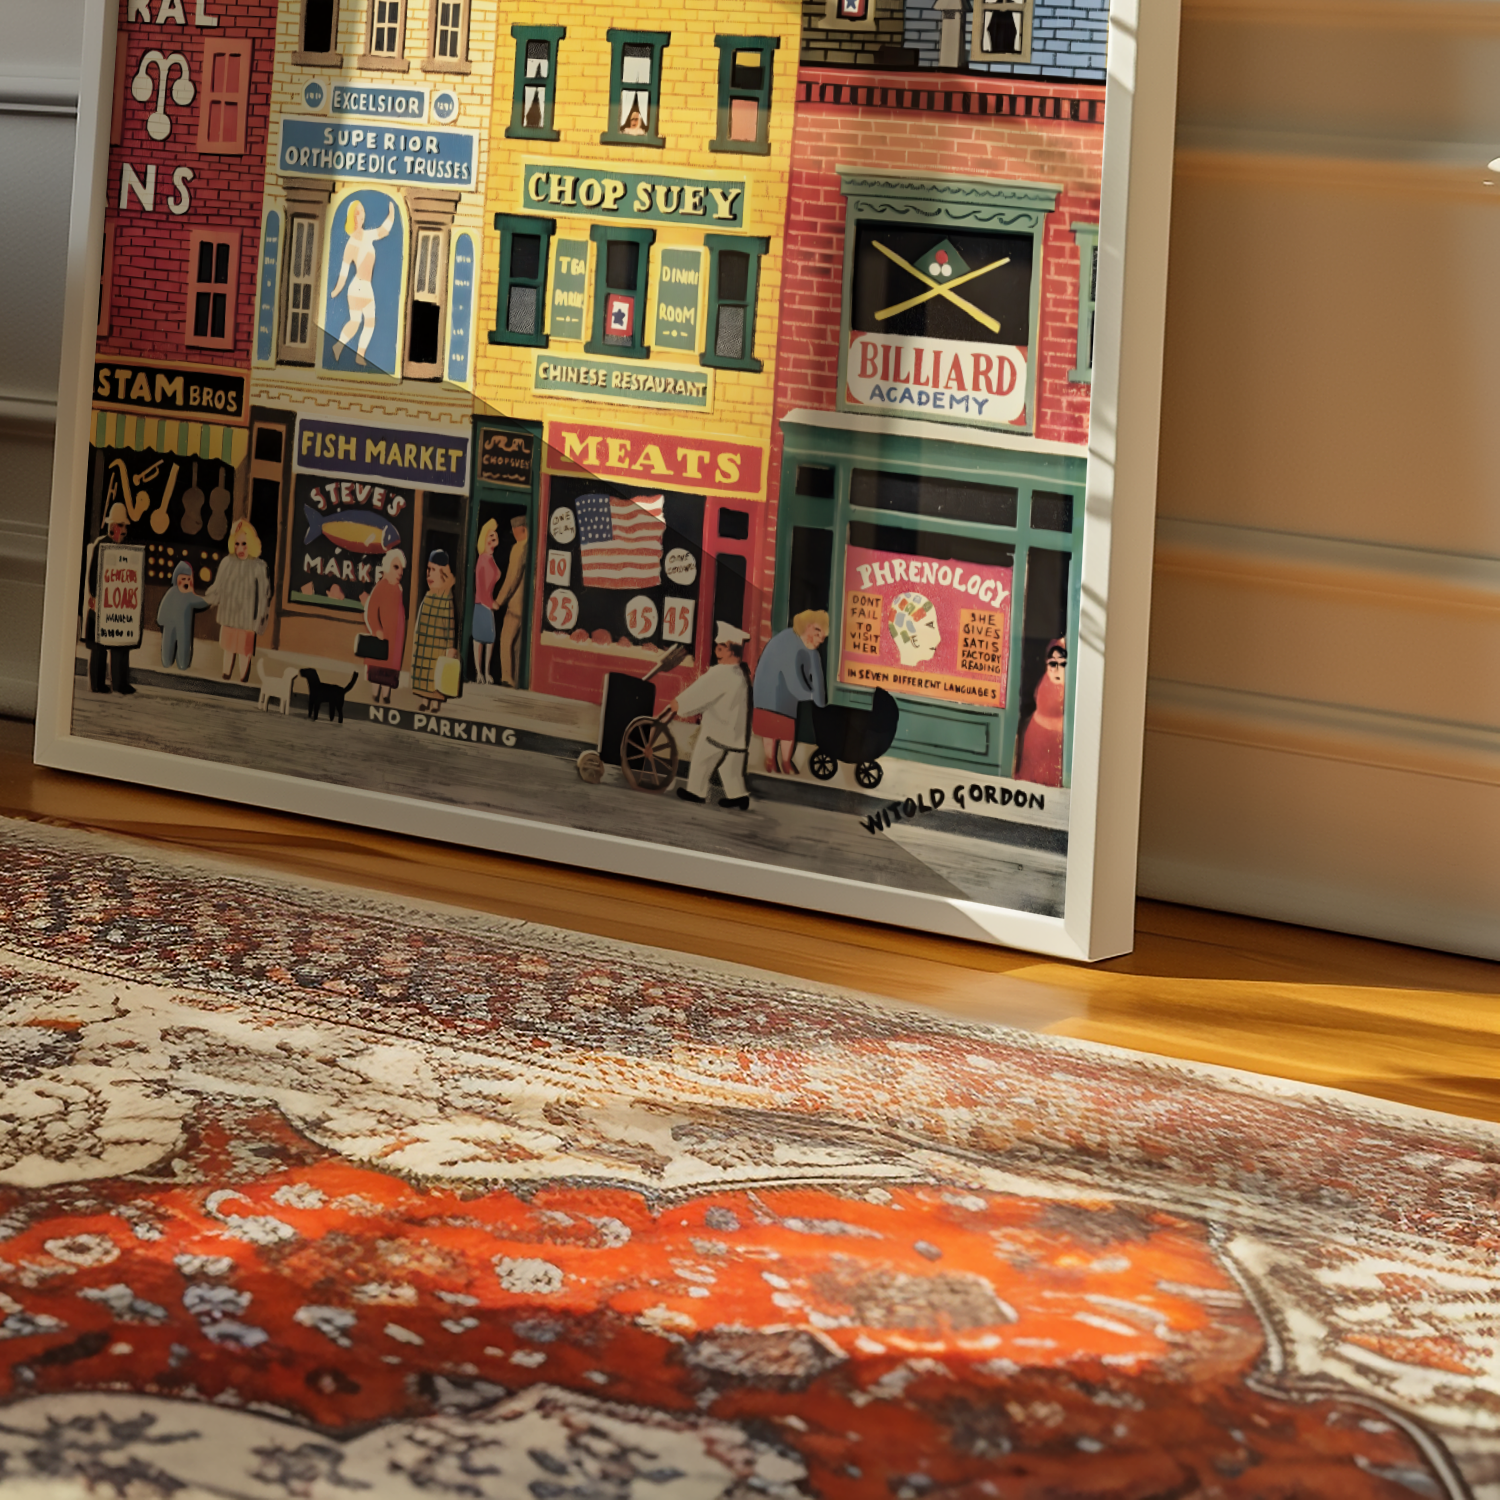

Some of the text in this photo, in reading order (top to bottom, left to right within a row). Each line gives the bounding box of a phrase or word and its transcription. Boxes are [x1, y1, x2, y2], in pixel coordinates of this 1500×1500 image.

[333, 90, 420, 115] EXCELSIOR
[323, 126, 441, 154] SUPERIOR
[285, 145, 470, 180] ORTHOPEDIC TRUSSES
[528, 171, 742, 221] CHOP SUEY
[659, 302, 696, 326] ROOM
[538, 361, 708, 398] CHINESE RESTAURANT
[857, 340, 1018, 397] BILLIARD
[94, 367, 238, 413] STAM BROS
[869, 383, 990, 416] ACADEMY
[301, 430, 464, 474] FISH MARKET
[560, 430, 742, 485] MEATS
[310, 481, 407, 517] STEVE'S
[303, 552, 385, 585] MARKE
[549, 558, 567, 577] 10
[856, 557, 1010, 609] PHRENOLOGY
[548, 596, 574, 627] 25
[850, 607, 879, 620] FAIL
[852, 594, 882, 608] DONT
[627, 605, 654, 636] 15
[663, 606, 690, 637] 45
[855, 621, 873, 632] TO
[963, 623, 1001, 640] GIVES
[971, 612, 996, 626] SHE
[849, 631, 881, 643] VISIT
[853, 641, 878, 655] HER
[963, 637, 1000, 653] SATIS
[960, 659, 1001, 674] READING
[961, 649, 1002, 664] FACTORY
[847, 668, 998, 700] IN SEVEN DIFFERENT LANGUAGES
[369, 705, 518, 747] NO PARKING
[859, 784, 1046, 836] WITOLD GORDON
